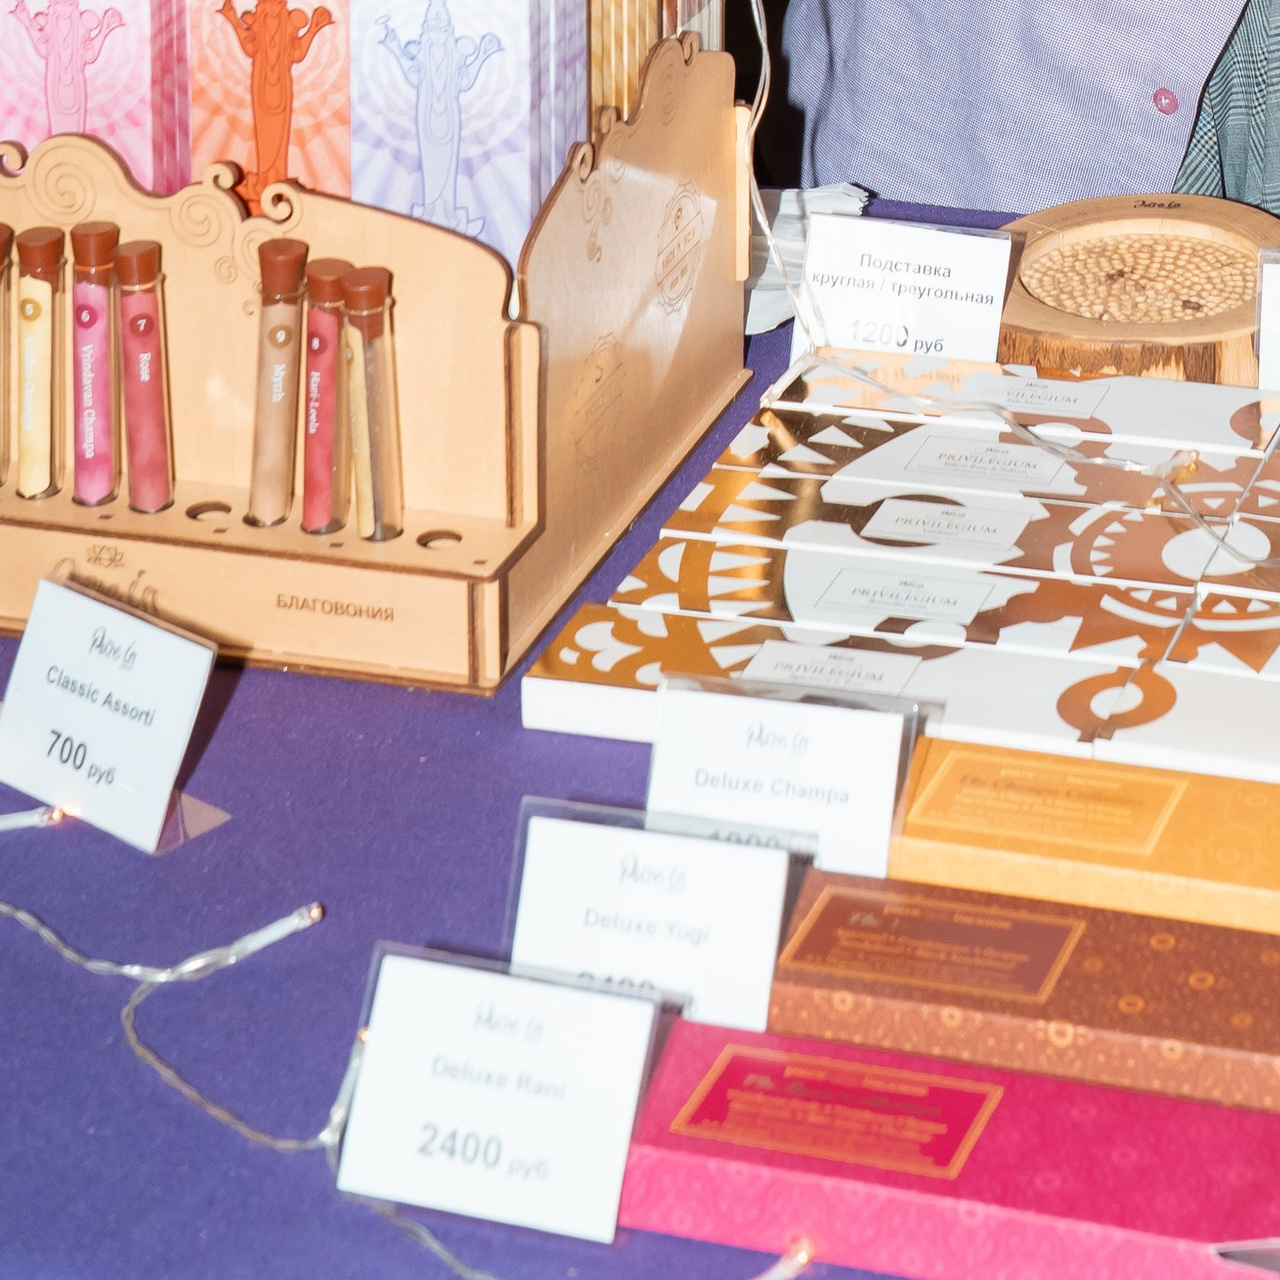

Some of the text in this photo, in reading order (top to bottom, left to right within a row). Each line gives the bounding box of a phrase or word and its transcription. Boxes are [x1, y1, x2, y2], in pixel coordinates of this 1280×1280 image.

[860, 253, 952, 279] Подставка
[811, 270, 995, 307] круглая треугольная
[137, 319, 147, 332] 7
[913, 339, 944, 354] руб
[139, 351, 152, 382] Rose
[81, 343, 96, 459] Vrindavan Champa
[938, 452, 1039, 470] PRIVILEGIUM
[895, 516, 998, 535] PRIVILEGIUM
[276, 594, 395, 623] БЛАГОВОНИЯ
[851, 586, 960, 608] PRIVILEGIUM
[774, 662, 886, 682] PRIVILEGIUM
[46, 664, 155, 727] Classic Assorti
[46, 728, 118, 786] 700 руб
[695, 768, 850, 804] Deluxe Champa
[584, 906, 710, 947] Deluxe Yogi
[432, 1056, 565, 1100] Deluxe Rani
[418, 1123, 549, 1181] 2400 руб
